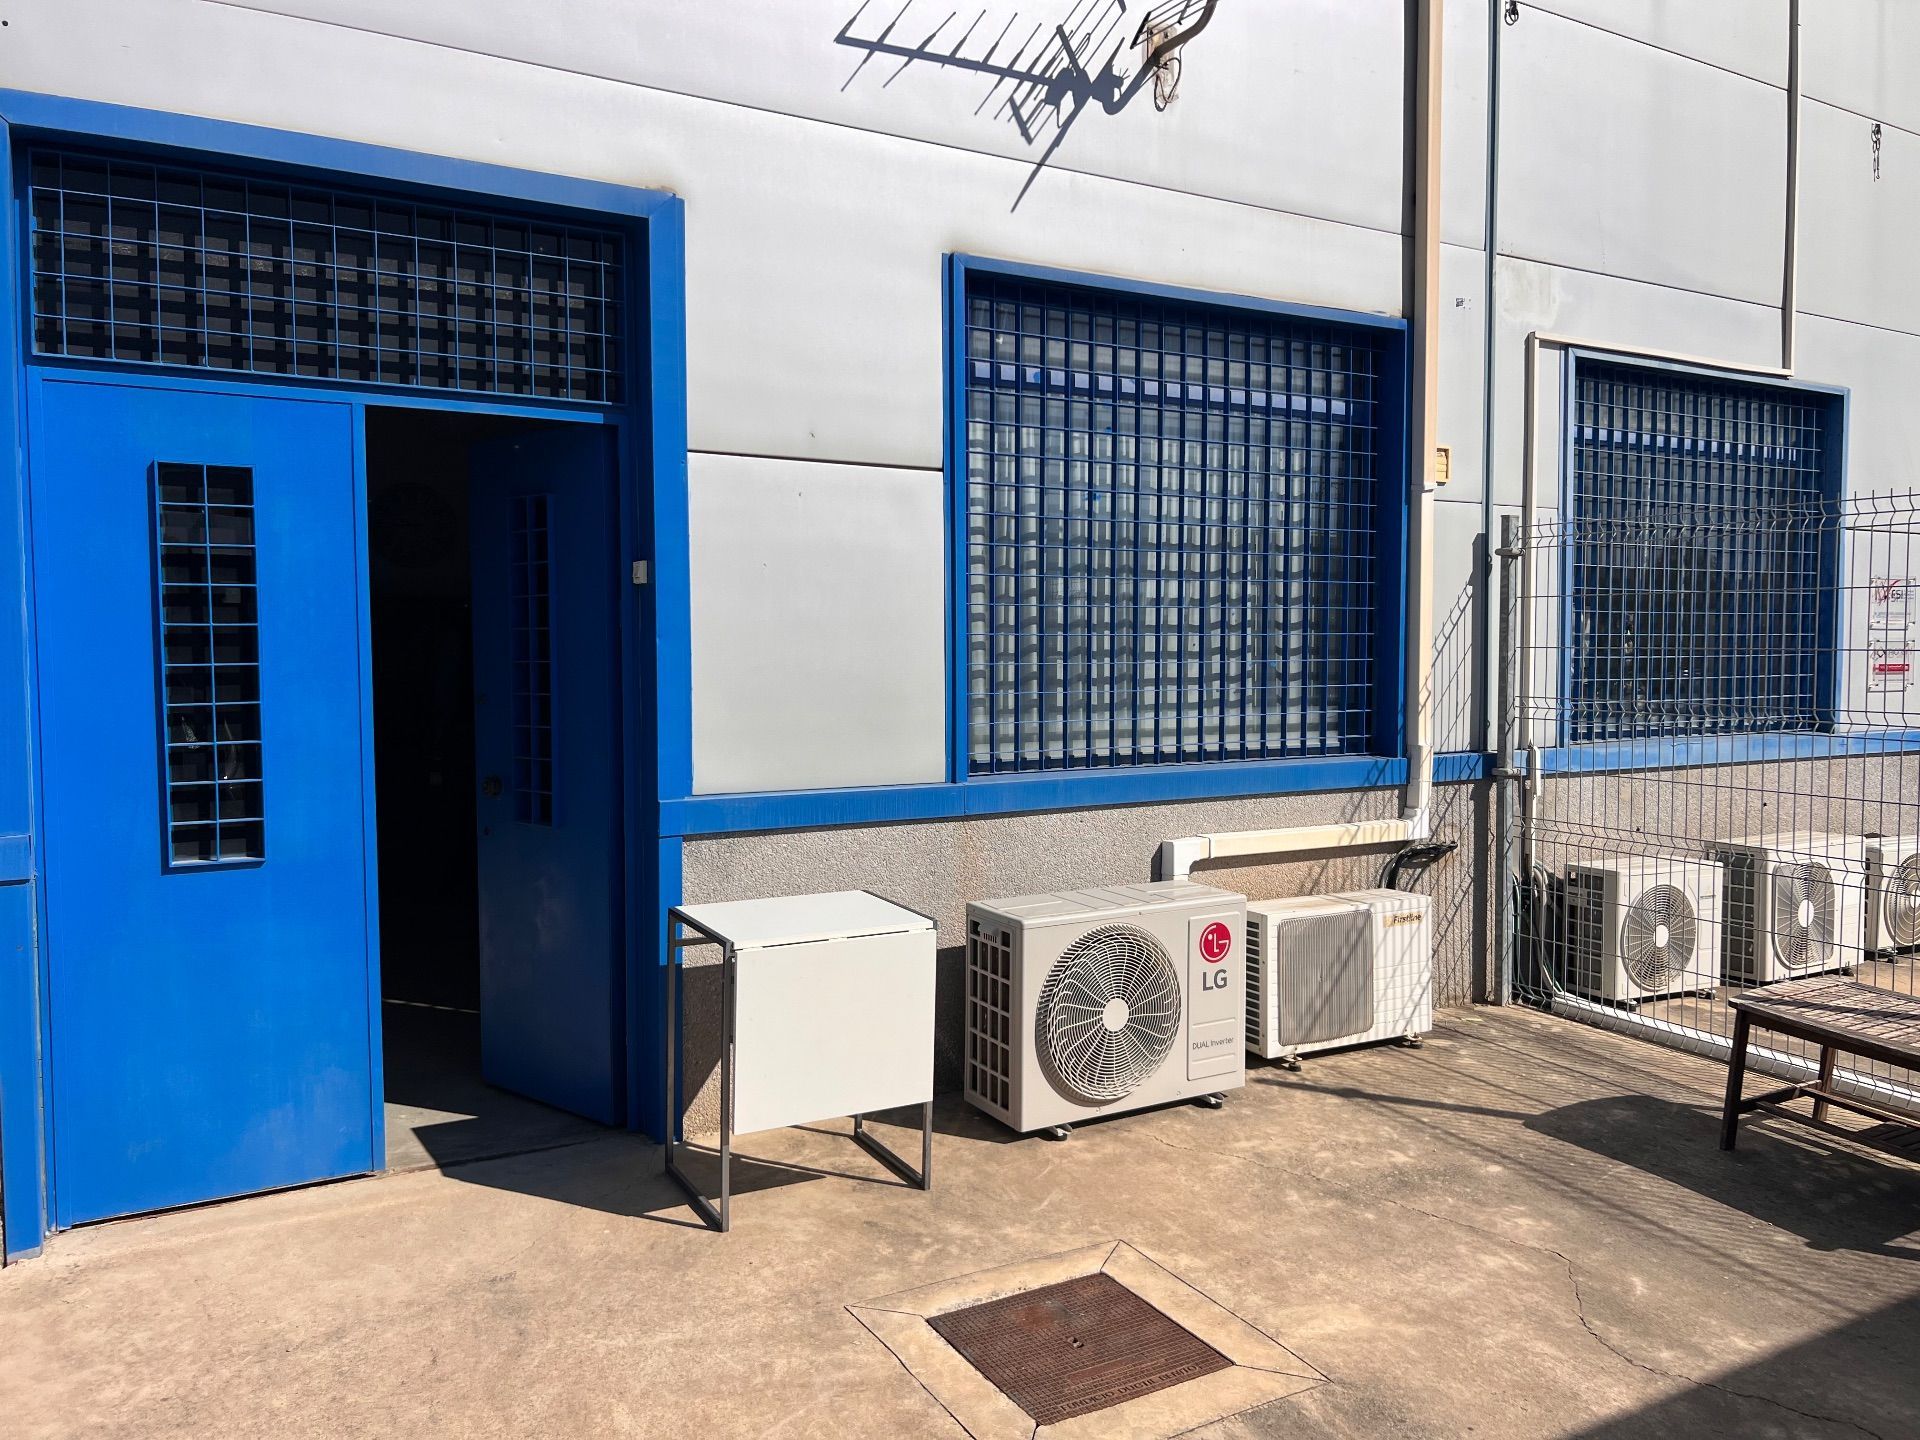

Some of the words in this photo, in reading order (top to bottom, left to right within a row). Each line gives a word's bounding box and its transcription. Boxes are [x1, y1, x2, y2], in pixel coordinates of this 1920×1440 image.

[1202, 969, 1228, 991] LG
[1192, 1040, 1210, 1050] DUAL
[1210, 1037, 1234, 1047] Inverter
